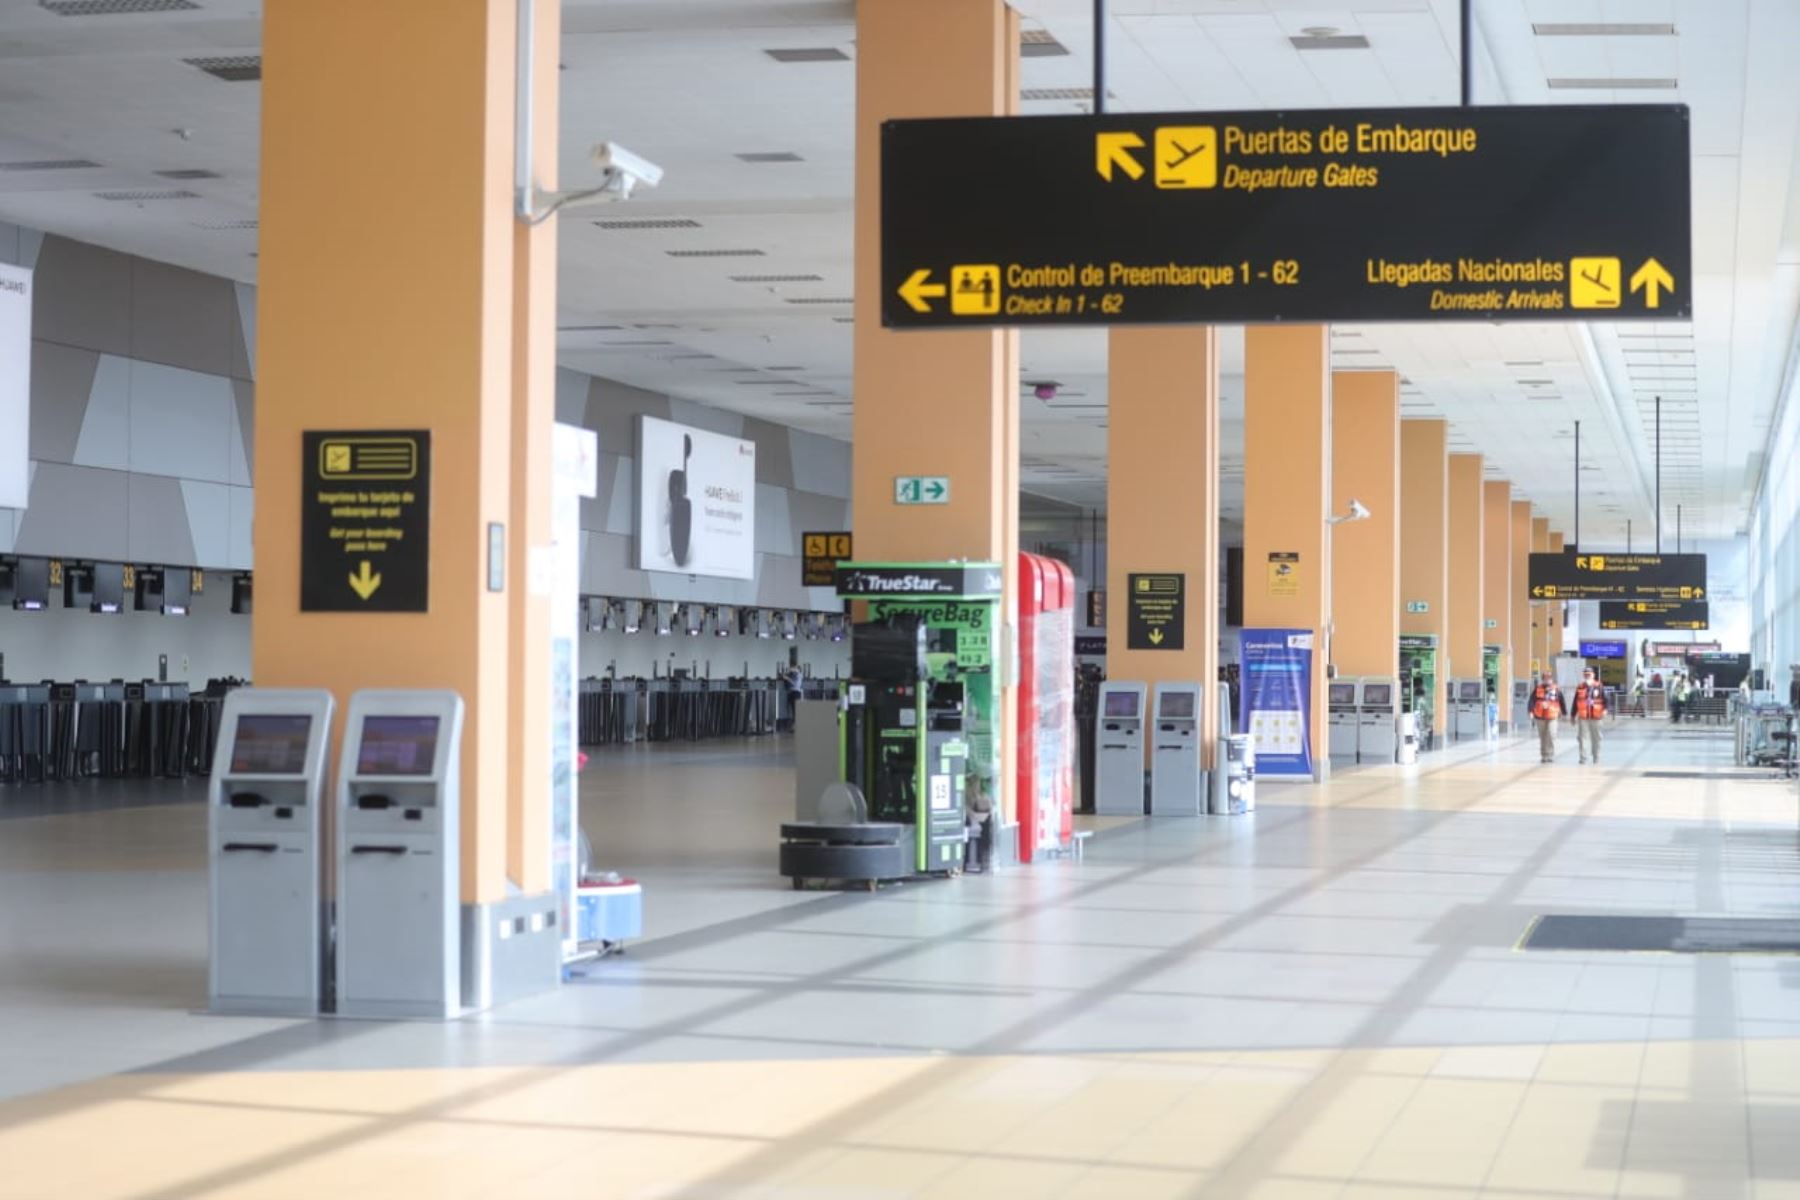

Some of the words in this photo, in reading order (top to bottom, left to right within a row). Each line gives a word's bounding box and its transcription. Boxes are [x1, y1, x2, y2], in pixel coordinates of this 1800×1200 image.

[1224, 126, 1312, 154] Puertas
[1320, 125, 1349, 153] de
[1357, 123, 1477, 157] Embarque
[1223, 164, 1318, 192] Departure
[1323, 162, 1378, 187] Gates
[1007, 264, 1075, 288] Control
[1080, 264, 1105, 287] de
[1110, 262, 1234, 290] Preembarque
[1240, 262, 1250, 284] 1
[1273, 260, 1299, 285] 62
[1367, 258, 1453, 288] Llegadas
[1458, 257, 1565, 283] Nacionales
[1006, 295, 1053, 315] Check
[1056, 296, 1072, 313] In
[1077, 296, 1085, 312] 1
[1101, 294, 1124, 313] 62
[1430, 290, 1503, 310] Domestic
[1505, 289, 1565, 309] Arrivals
[867, 574, 939, 591] TrueStar
